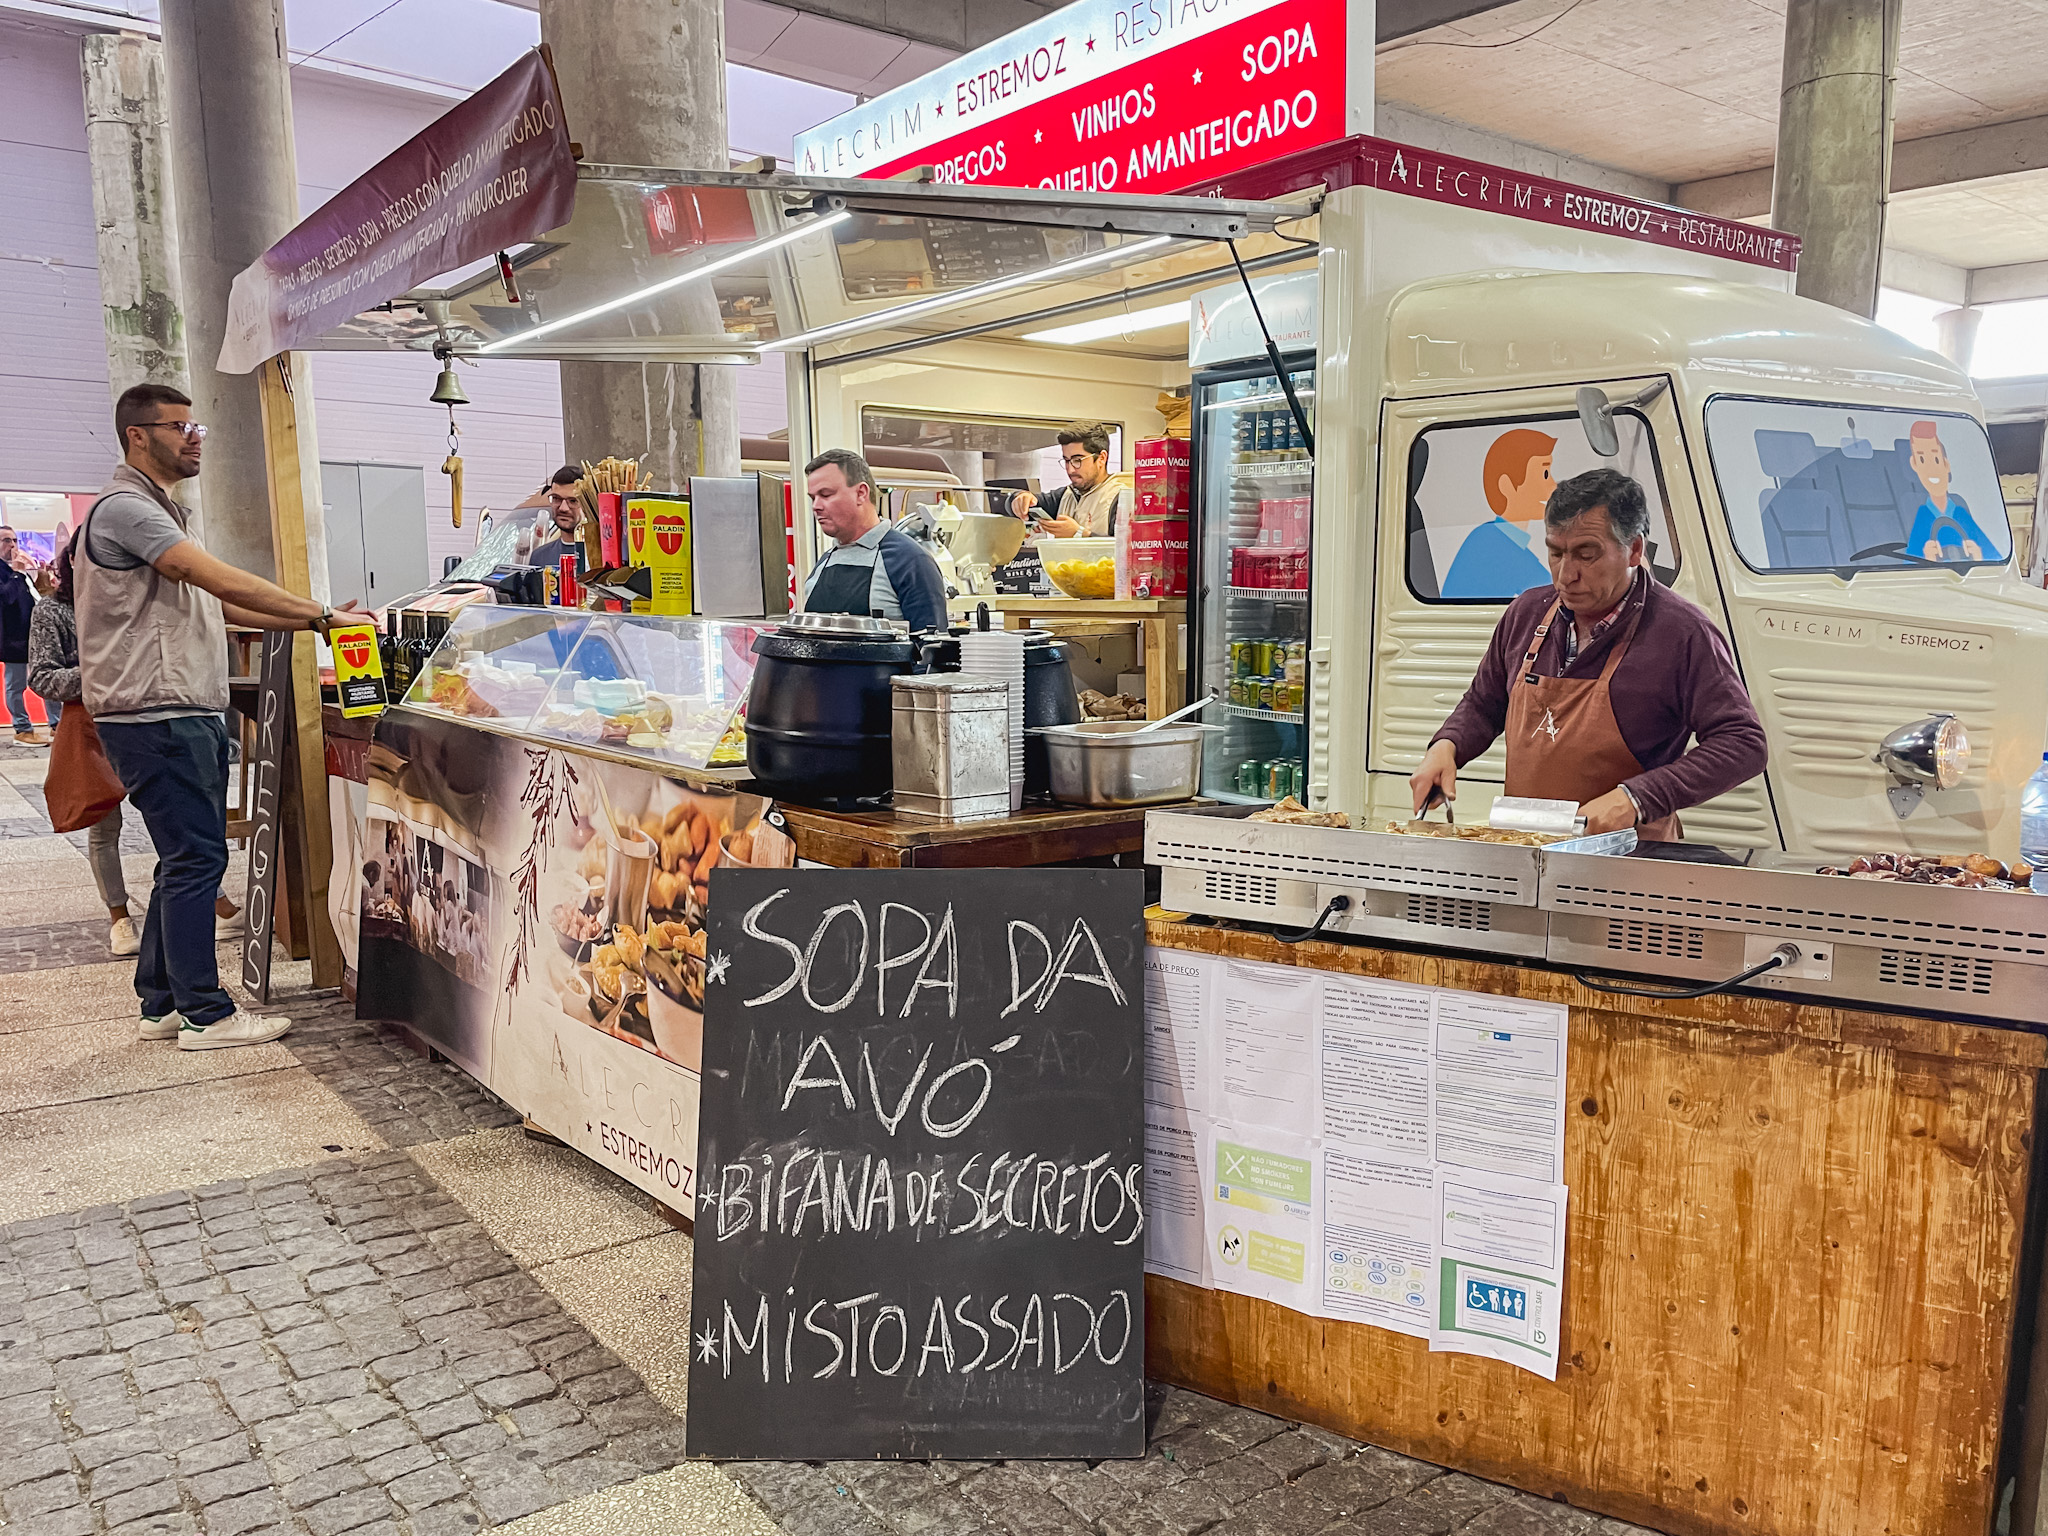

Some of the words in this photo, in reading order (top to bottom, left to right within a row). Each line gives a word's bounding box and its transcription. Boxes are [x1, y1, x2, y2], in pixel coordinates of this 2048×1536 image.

[804, 102, 921, 174] ALECRIM
[957, 36, 1067, 117] ESTREMOZ
[934, 140, 1006, 184] PREGOS
[1072, 83, 1156, 142] VINHOS
[1241, 22, 1317, 82] SOPA
[1125, 90, 1317, 183] AMANTEIGADO
[324, 235, 357, 270] SECRETOS
[357, 219, 382, 249] SOPA
[381, 194, 418, 232] PREGOS
[416, 177, 439, 212] COM
[440, 153, 473, 198] QUEIJO
[474, 100, 556, 170] AMANTEIGADO
[1389, 149, 1531, 210] ALECRIM
[1564, 193, 1651, 235] ESTREMOZ
[1678, 217, 1782, 263] RESTAURANTE
[318, 276, 350, 309] PRESUNTO
[351, 263, 370, 291] COM
[370, 249, 396, 285] QUEIJO
[397, 212, 449, 265] AMANTEIGADO
[456, 167, 529, 227] HAMBURGUER
[1131, 540, 1162, 550] VAQUEIRA
[338, 641, 372, 650] PALADIN
[1764, 617, 1862, 639] ALECRIM
[1900, 633, 1970, 651] ESTREMOZ
[742, 888, 959, 1018] SOPA
[1001, 916, 1128, 1019] DA
[1160, 962, 1169, 971] DE
[1171, 964, 1200, 976] PREÇOS
[781, 1034, 1021, 1138] AVÓ
[600, 1121, 695, 1199] ESTREMOZ
[906, 1168, 941, 1226] DE
[949, 1151, 1144, 1245] SECRETOS
[1262, 1168, 1290, 1180] SMOKERS
[1266, 1160, 1304, 1173] FUMADORES
[918, 1290, 1131, 1377] ASSADO
